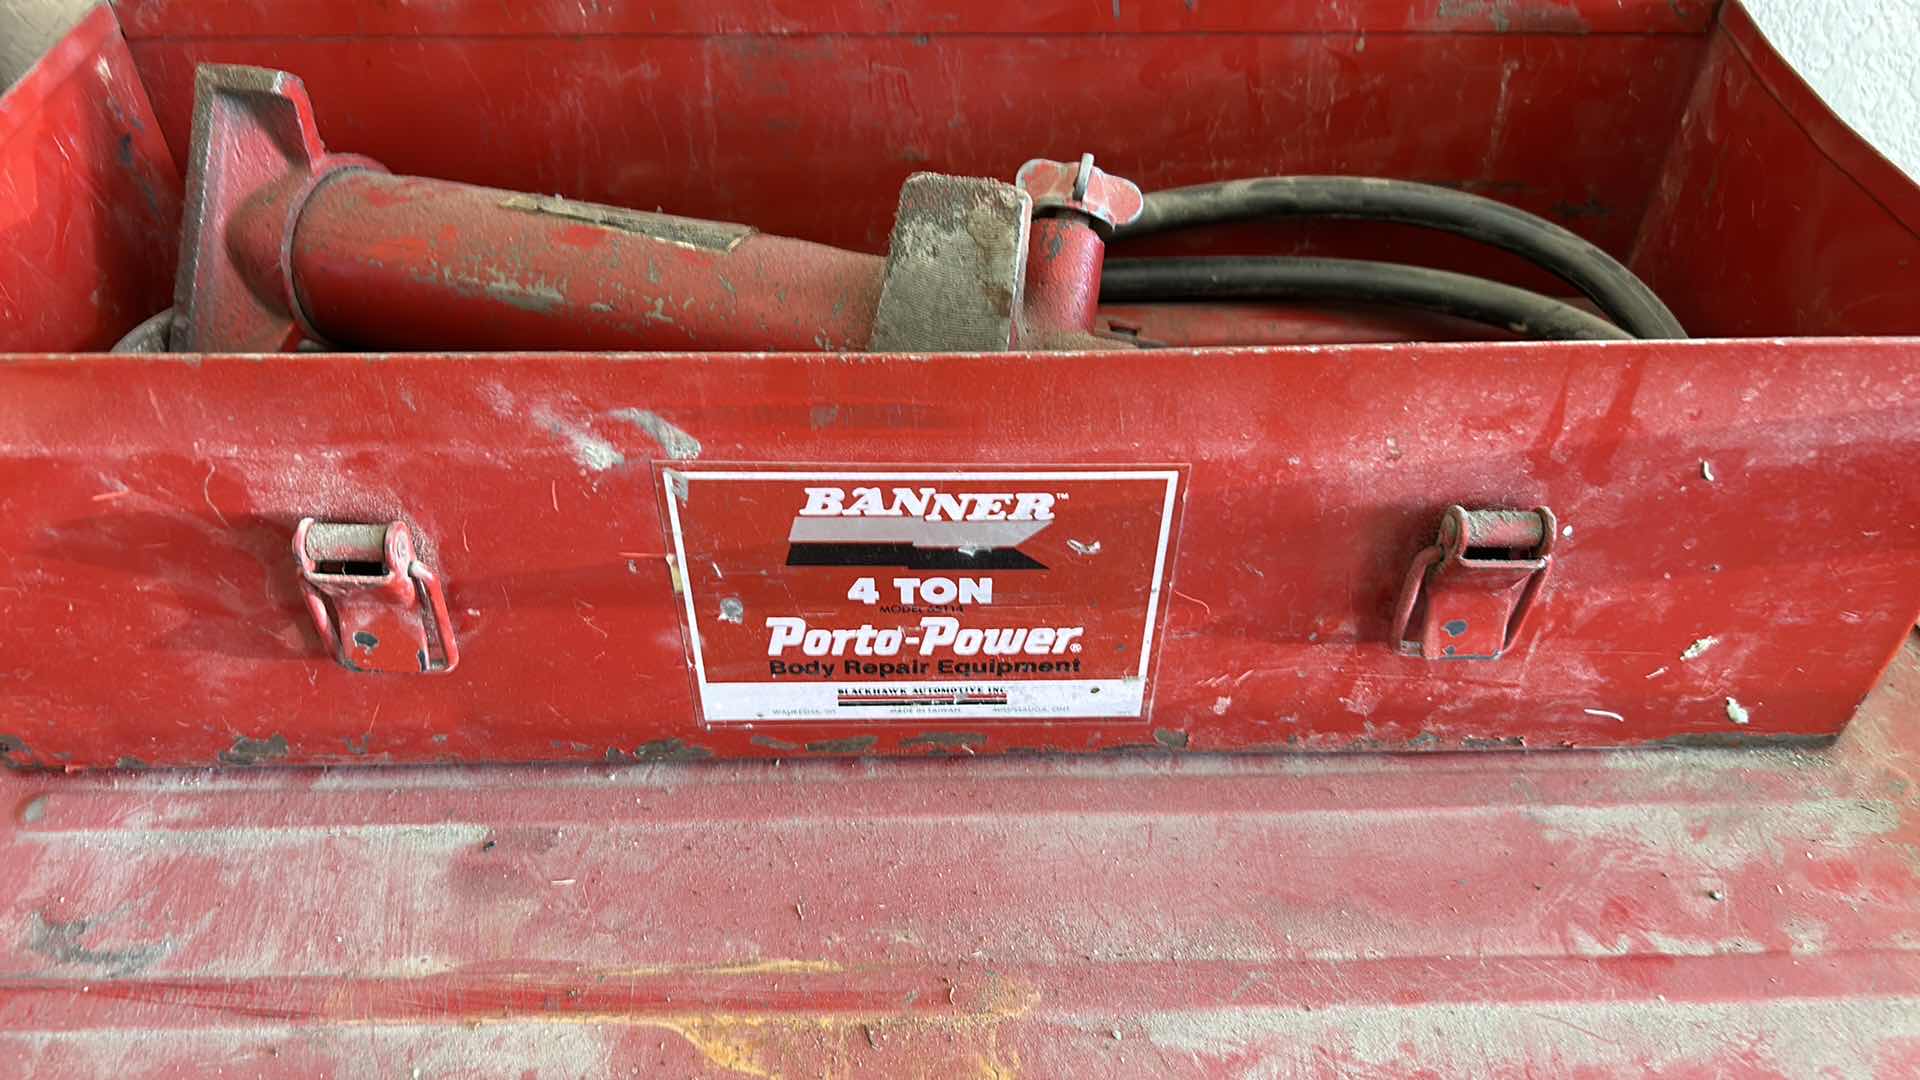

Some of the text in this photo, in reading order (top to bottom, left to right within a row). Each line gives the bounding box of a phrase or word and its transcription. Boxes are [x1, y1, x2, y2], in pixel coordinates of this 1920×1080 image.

[847, 577, 993, 605] 4 TON
[880, 605, 923, 614] MODEL
[769, 658, 1081, 677] Body Repair Equipment
[837, 688, 906, 696] BLACKHAWK
[912, 687, 982, 695] AUTOMOTIVE
